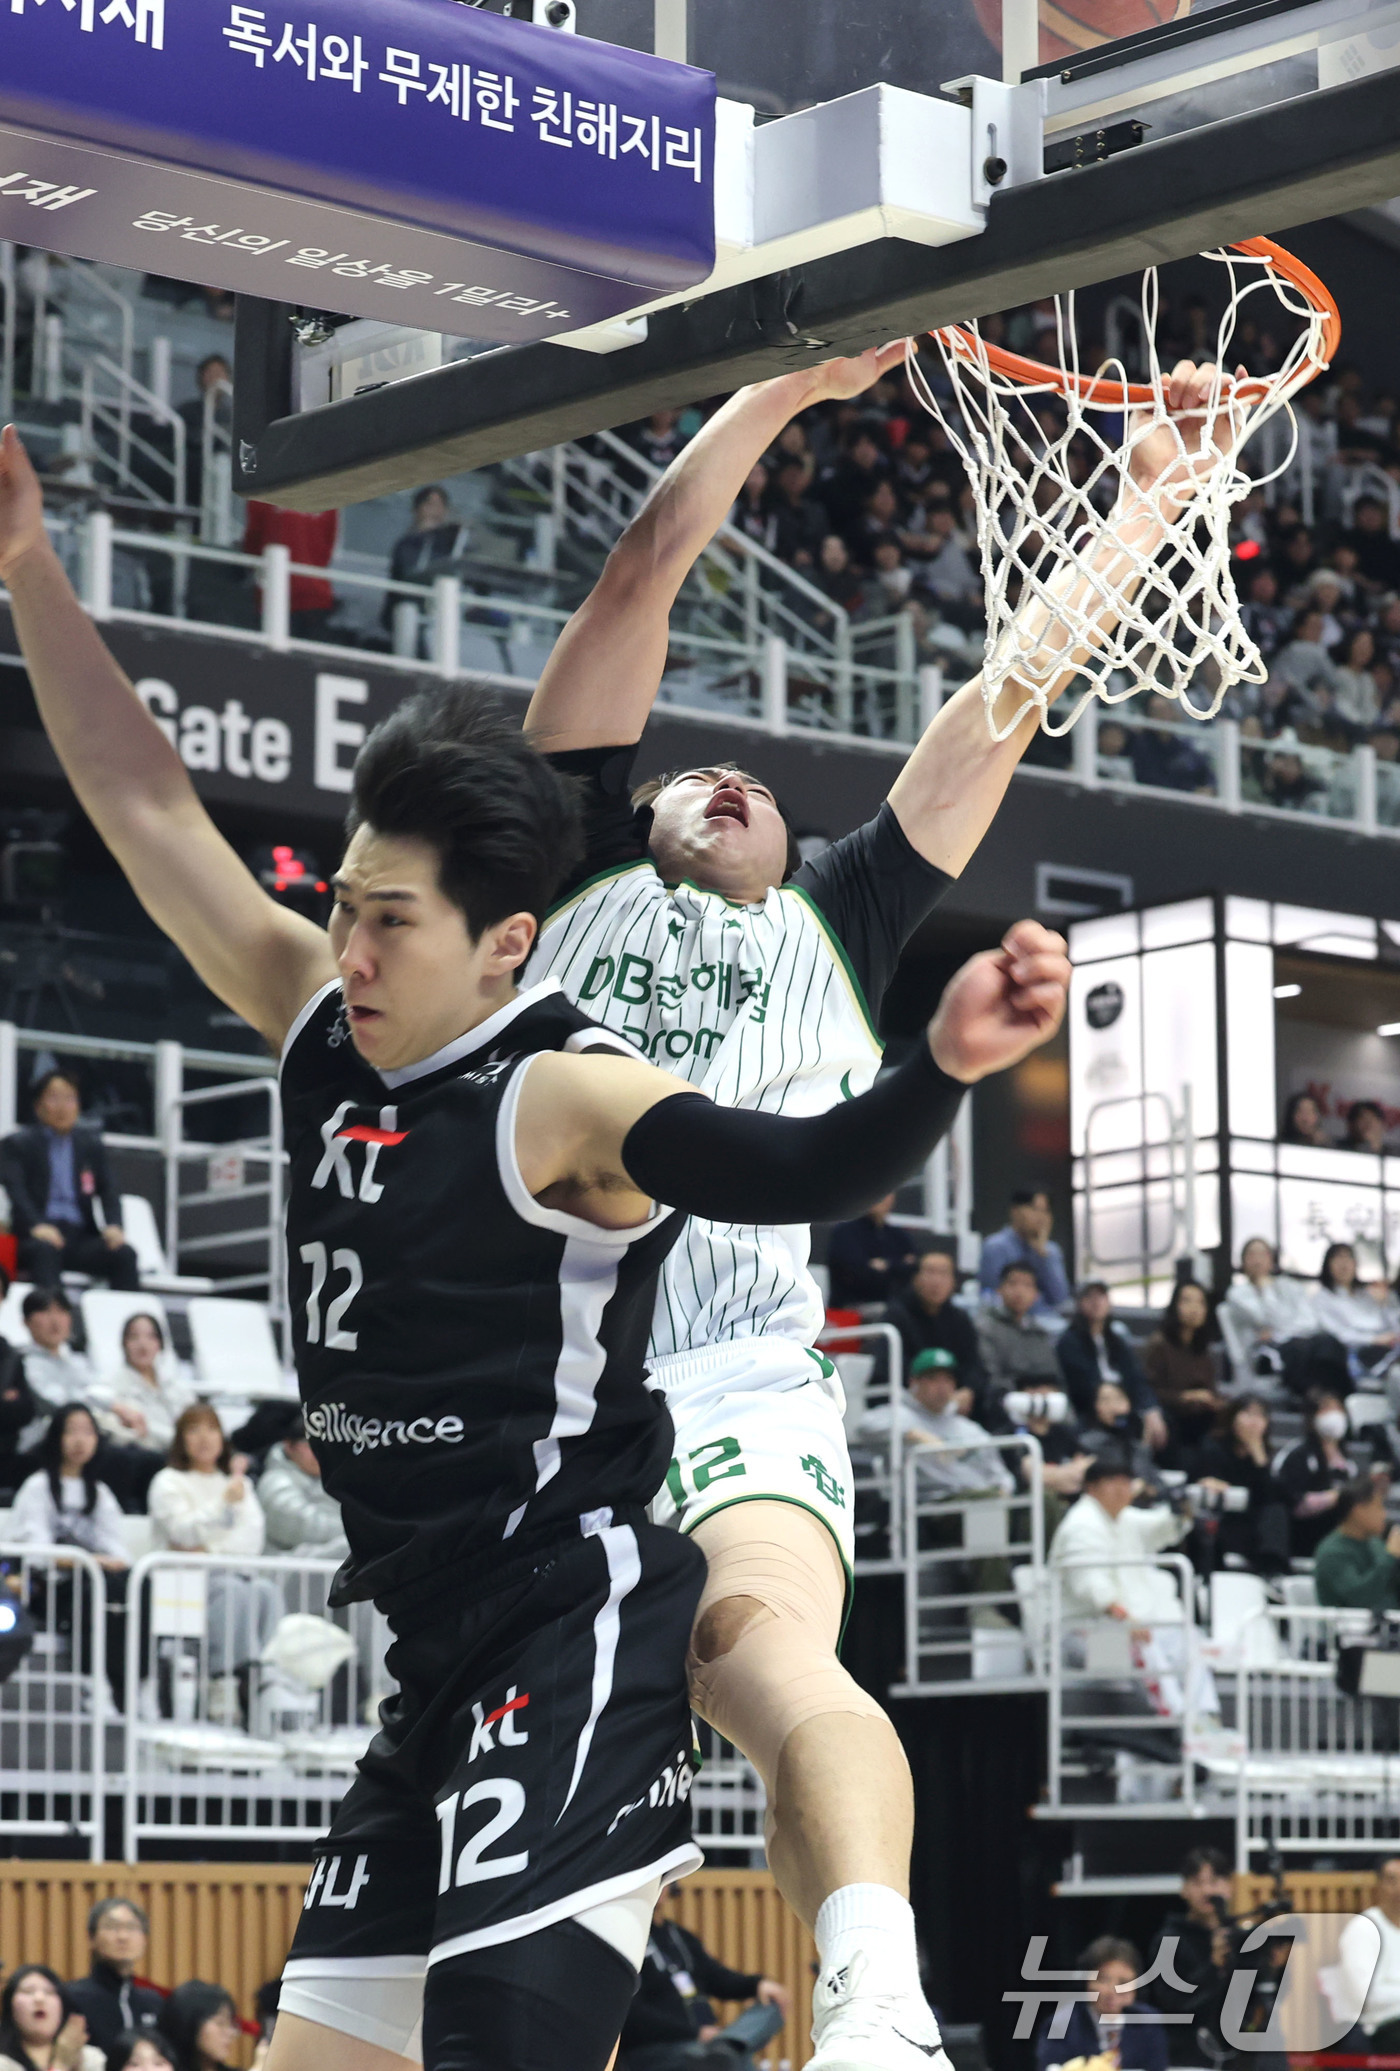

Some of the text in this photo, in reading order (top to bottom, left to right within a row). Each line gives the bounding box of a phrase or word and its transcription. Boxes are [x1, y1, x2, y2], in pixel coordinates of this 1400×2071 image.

[222, 4, 702, 183] 독서와 무제한 친해지리
[132, 210, 572, 319] 당신의 일상을 1밀리+
[134, 672, 369, 793] Gate E
[310, 1100, 412, 1204] kt
[300, 1241, 365, 1352] 12
[665, 1436, 747, 1512] 12
[468, 1685, 530, 1763] kt
[435, 1777, 530, 1896] 12
